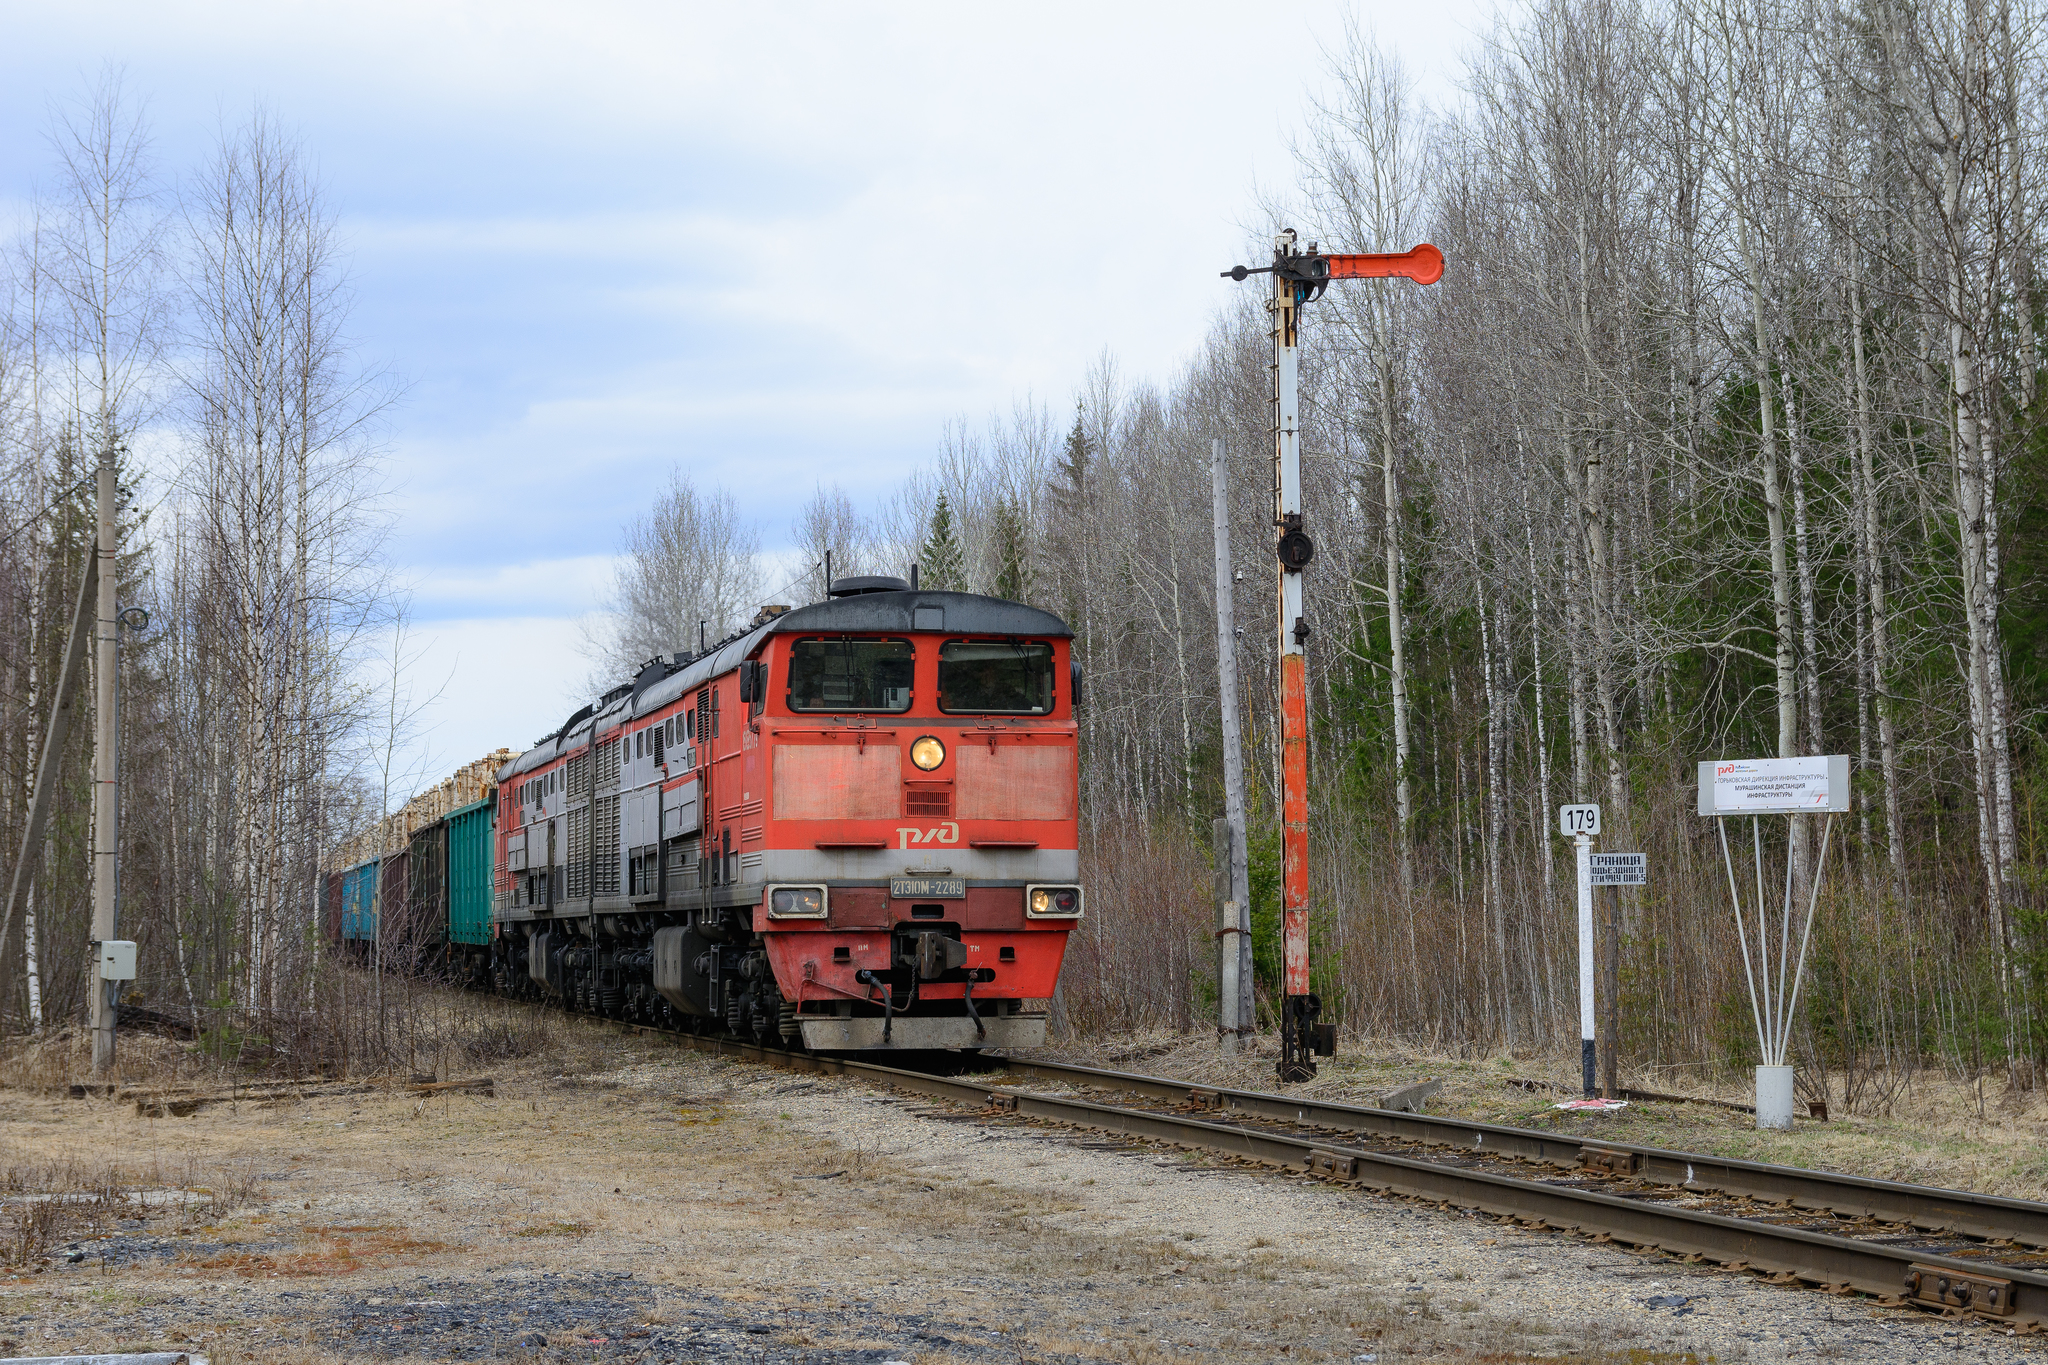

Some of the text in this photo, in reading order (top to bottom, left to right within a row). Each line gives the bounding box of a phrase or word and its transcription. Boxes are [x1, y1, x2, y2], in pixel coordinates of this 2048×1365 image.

[1717, 774, 1825, 784] ГОРЬКОВСКАЯ ДИРЕКЦИЯ ИНФРАСТРУКТУРЫ
[1746, 791, 1793, 799] ИНФРАСТРУКТУРЫ
[1567, 809, 1595, 830] 179
[1590, 855, 1641, 866] ГРАНИЦА
[893, 880, 963, 895] 2ТЭ10М-2289
